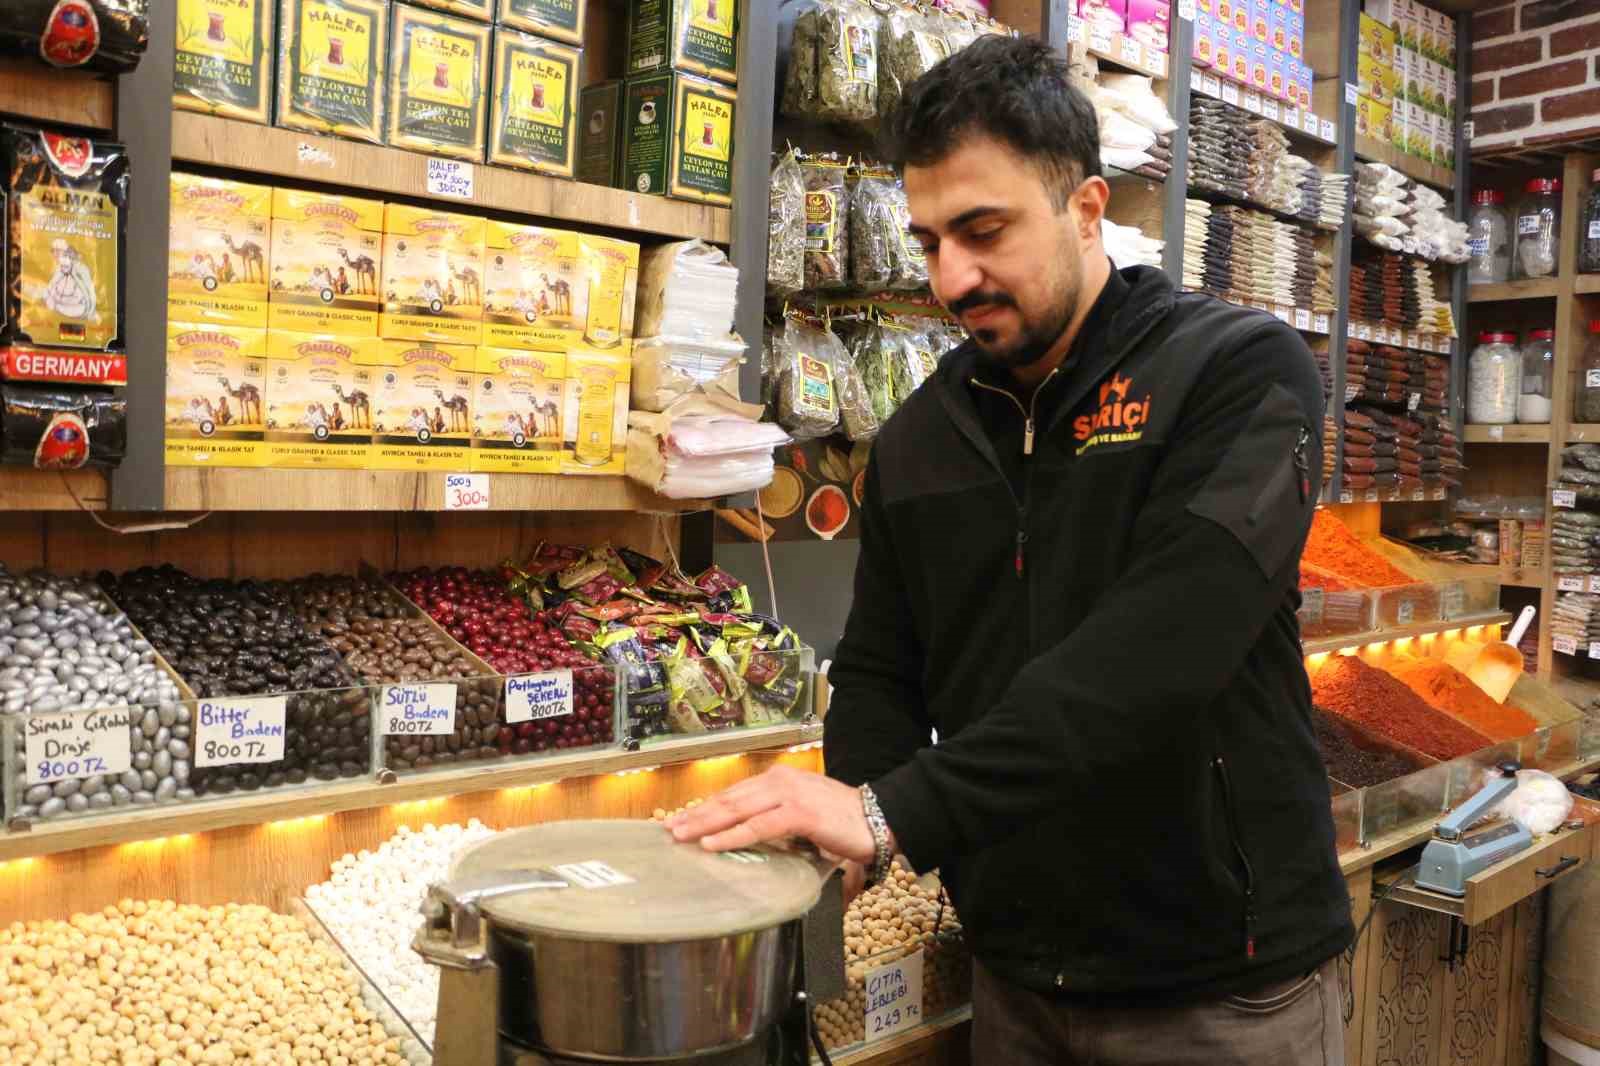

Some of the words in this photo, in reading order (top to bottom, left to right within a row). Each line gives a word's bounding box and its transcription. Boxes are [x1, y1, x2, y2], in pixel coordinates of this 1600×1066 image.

[517, 59, 562, 79] HALEP
[15, 353, 113, 378] GERMANY
[452, 488, 481, 508] 300
[201, 703, 250, 726] Bitter
[874, 1008, 901, 1033] 249
